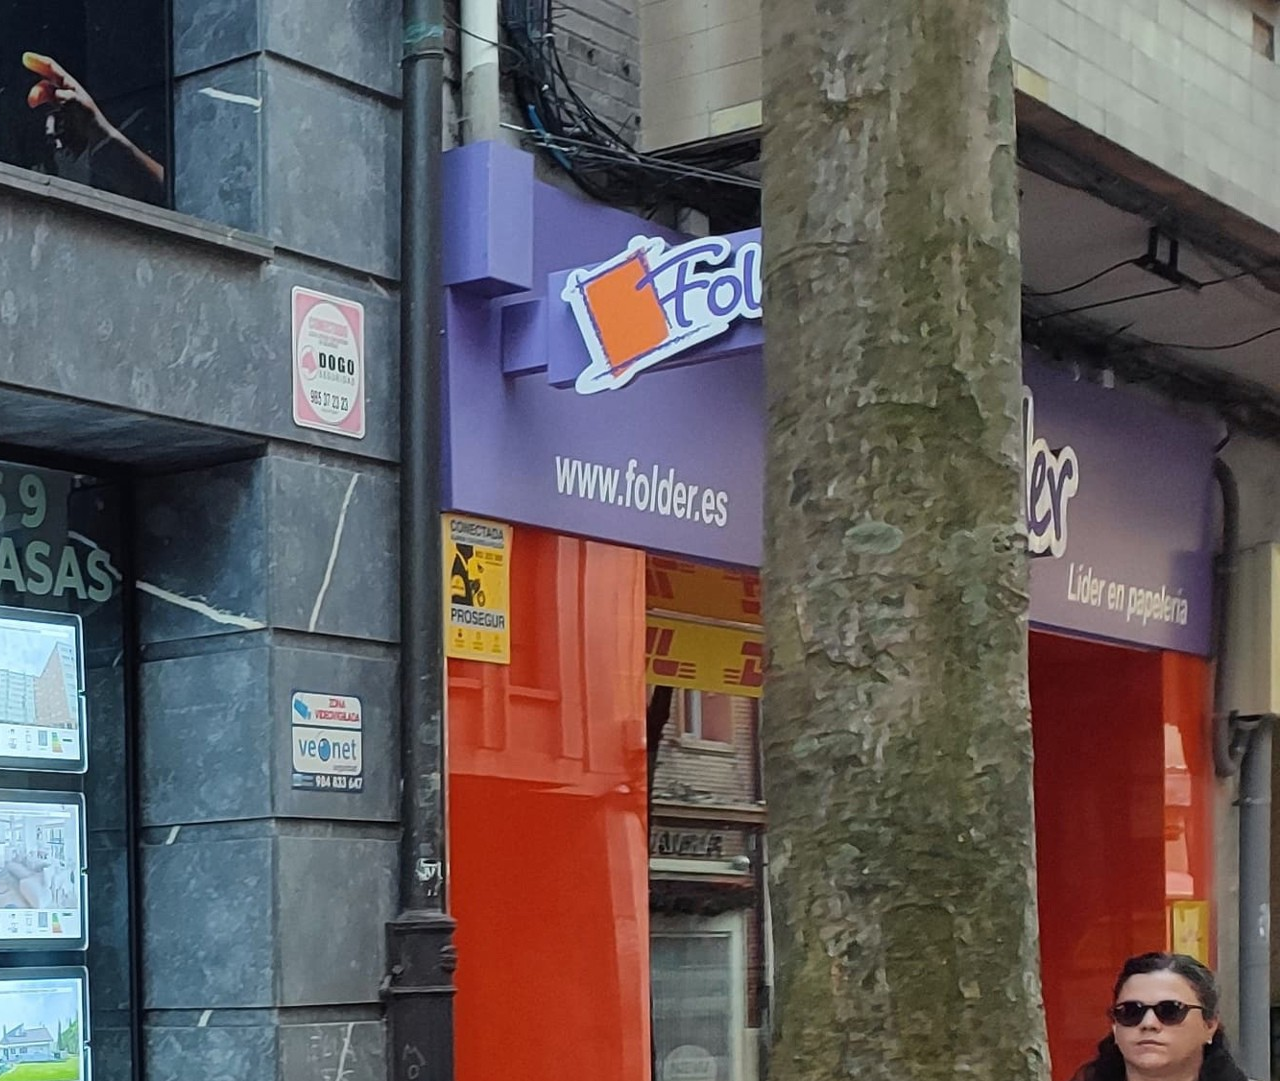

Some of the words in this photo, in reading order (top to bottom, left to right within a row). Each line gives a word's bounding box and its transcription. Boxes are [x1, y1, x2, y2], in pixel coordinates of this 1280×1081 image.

[636, 243, 761, 328] Fol
[319, 352, 354, 376] DOGO
[20, 474, 47, 528] 9
[555, 455, 729, 527] www.folder.es
[451, 608, 505, 629] PROSEGUR
[1067, 563, 1104, 607] Líder
[1108, 580, 1125, 611] en
[1127, 585, 1188, 626] papelería
[298, 738, 357, 761] veonet
